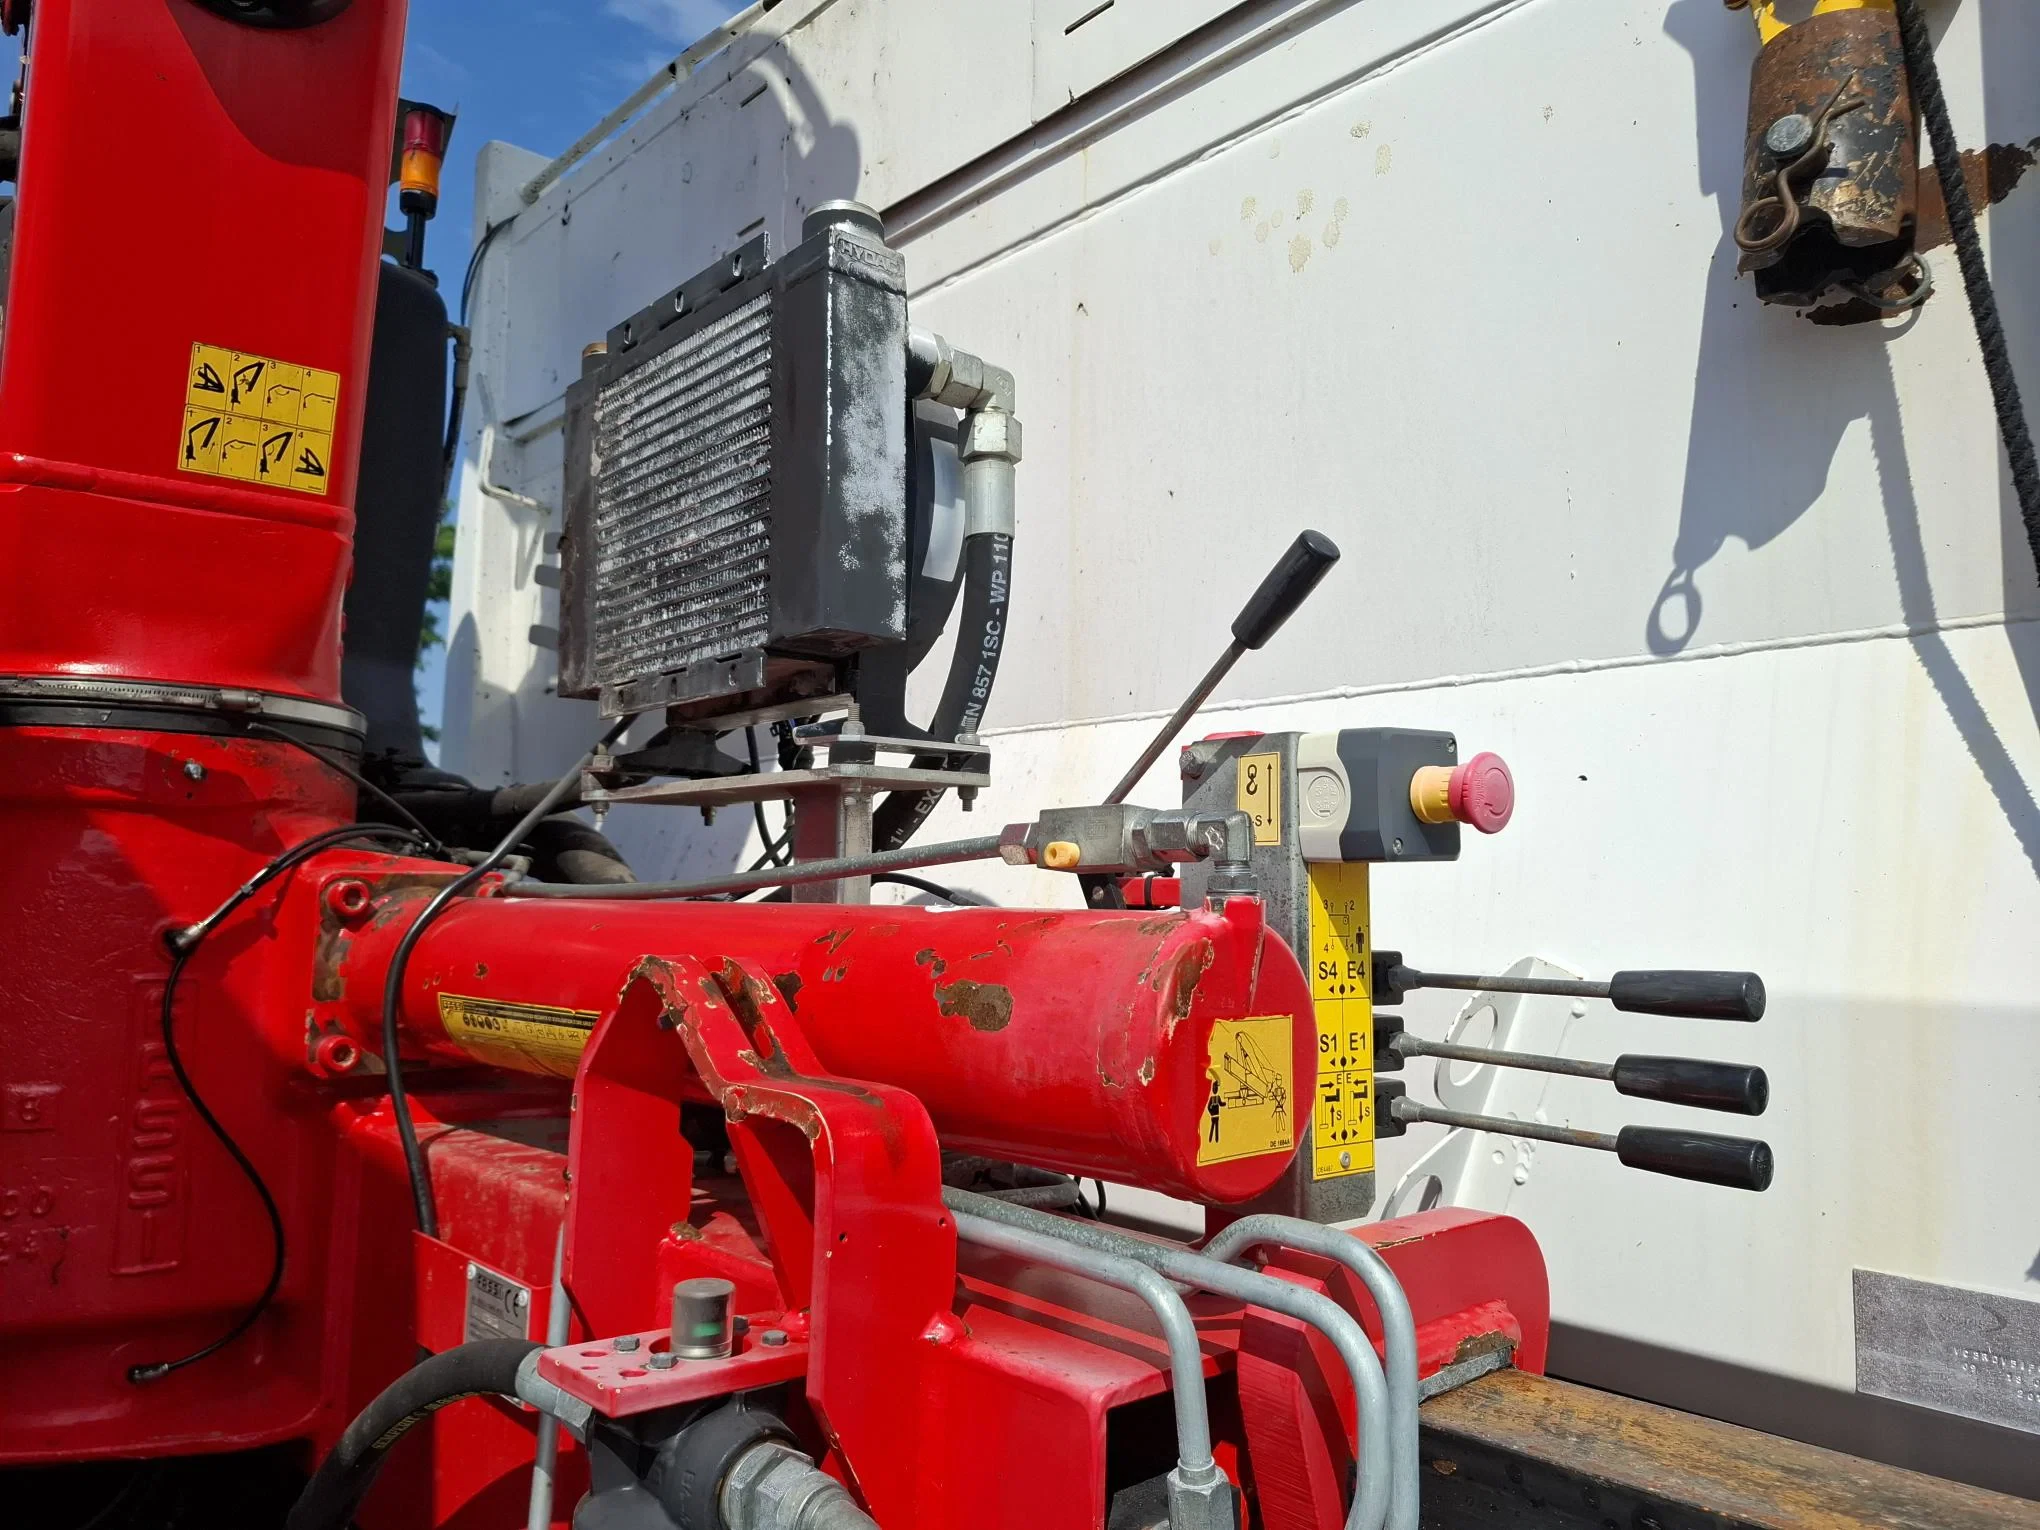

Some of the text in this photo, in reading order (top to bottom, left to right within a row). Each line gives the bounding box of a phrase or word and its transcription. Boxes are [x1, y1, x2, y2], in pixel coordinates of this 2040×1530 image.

[990, 570, 1006, 604] WP
[982, 620, 1001, 658] 1SC
[972, 665, 992, 699] 857
[1324, 899, 1329, 910] 3
[1350, 900, 1355, 911] 2
[1324, 943, 1329, 953] 4
[1319, 961, 1338, 980] S4
[1347, 961, 1366, 979] E4
[1320, 1033, 1337, 1053] S1
[1349, 1032, 1366, 1051] E1
[1337, 1073, 1342, 1084] E
[1346, 1072, 1351, 1083] E
[1336, 1110, 1342, 1121] S
[1365, 1106, 1370, 1117] S
